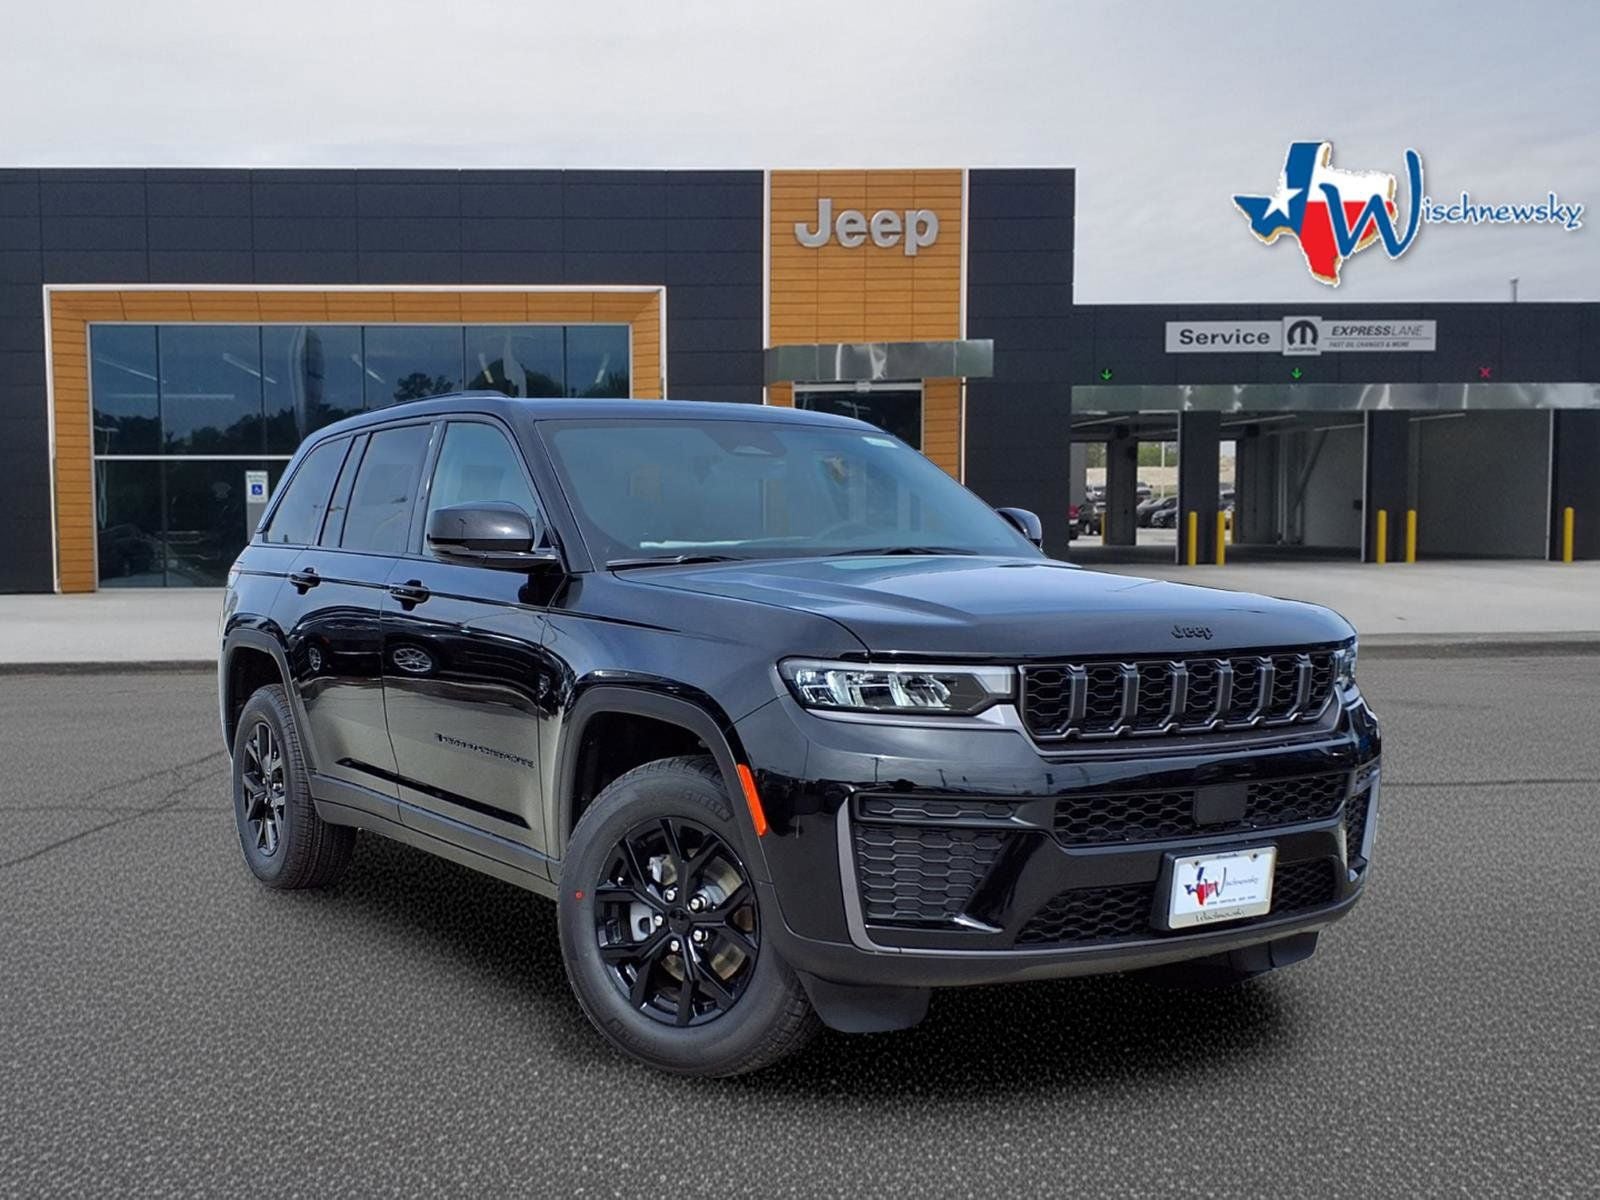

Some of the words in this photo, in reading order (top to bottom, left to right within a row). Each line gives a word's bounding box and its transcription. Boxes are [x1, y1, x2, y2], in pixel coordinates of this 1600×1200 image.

[794, 198, 939, 256] Jeep
[1179, 328, 1270, 345] Service
[1171, 625, 1213, 640] Jeep
